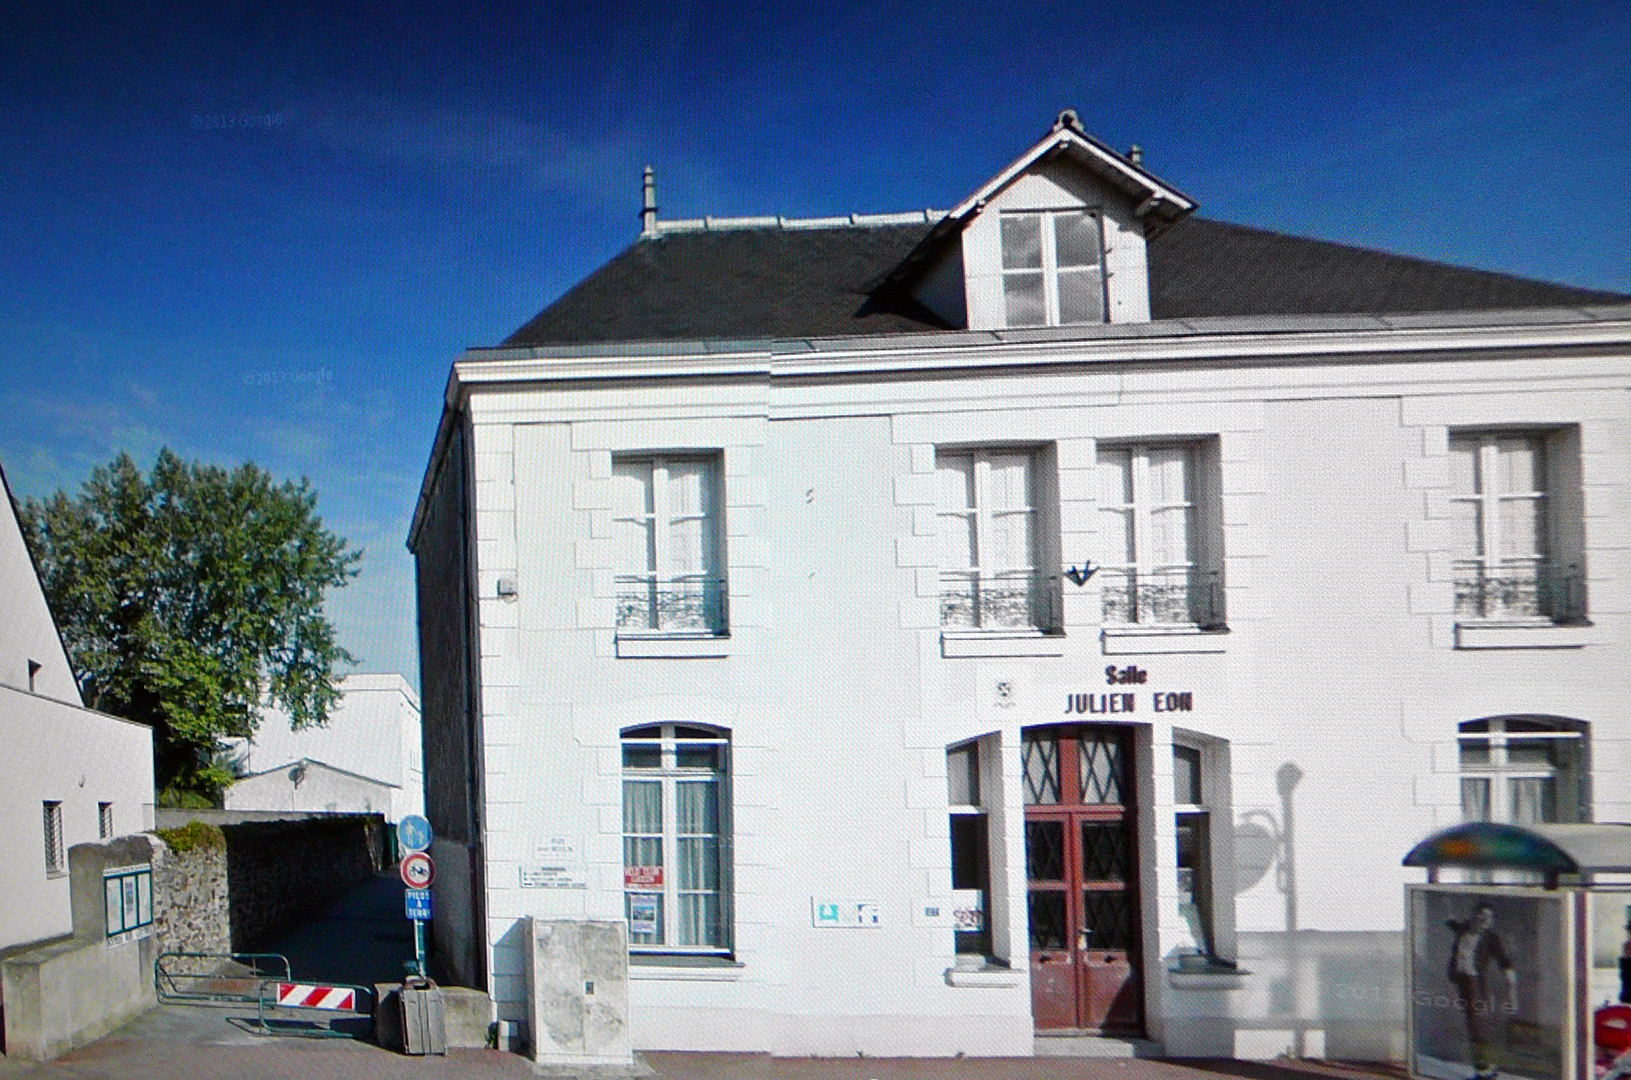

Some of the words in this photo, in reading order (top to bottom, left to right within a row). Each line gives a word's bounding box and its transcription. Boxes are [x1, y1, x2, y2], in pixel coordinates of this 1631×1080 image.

[1104, 665, 1147, 685] Salle
[1065, 693, 1135, 714] JULIEN
[1153, 692, 1193, 712] EON
